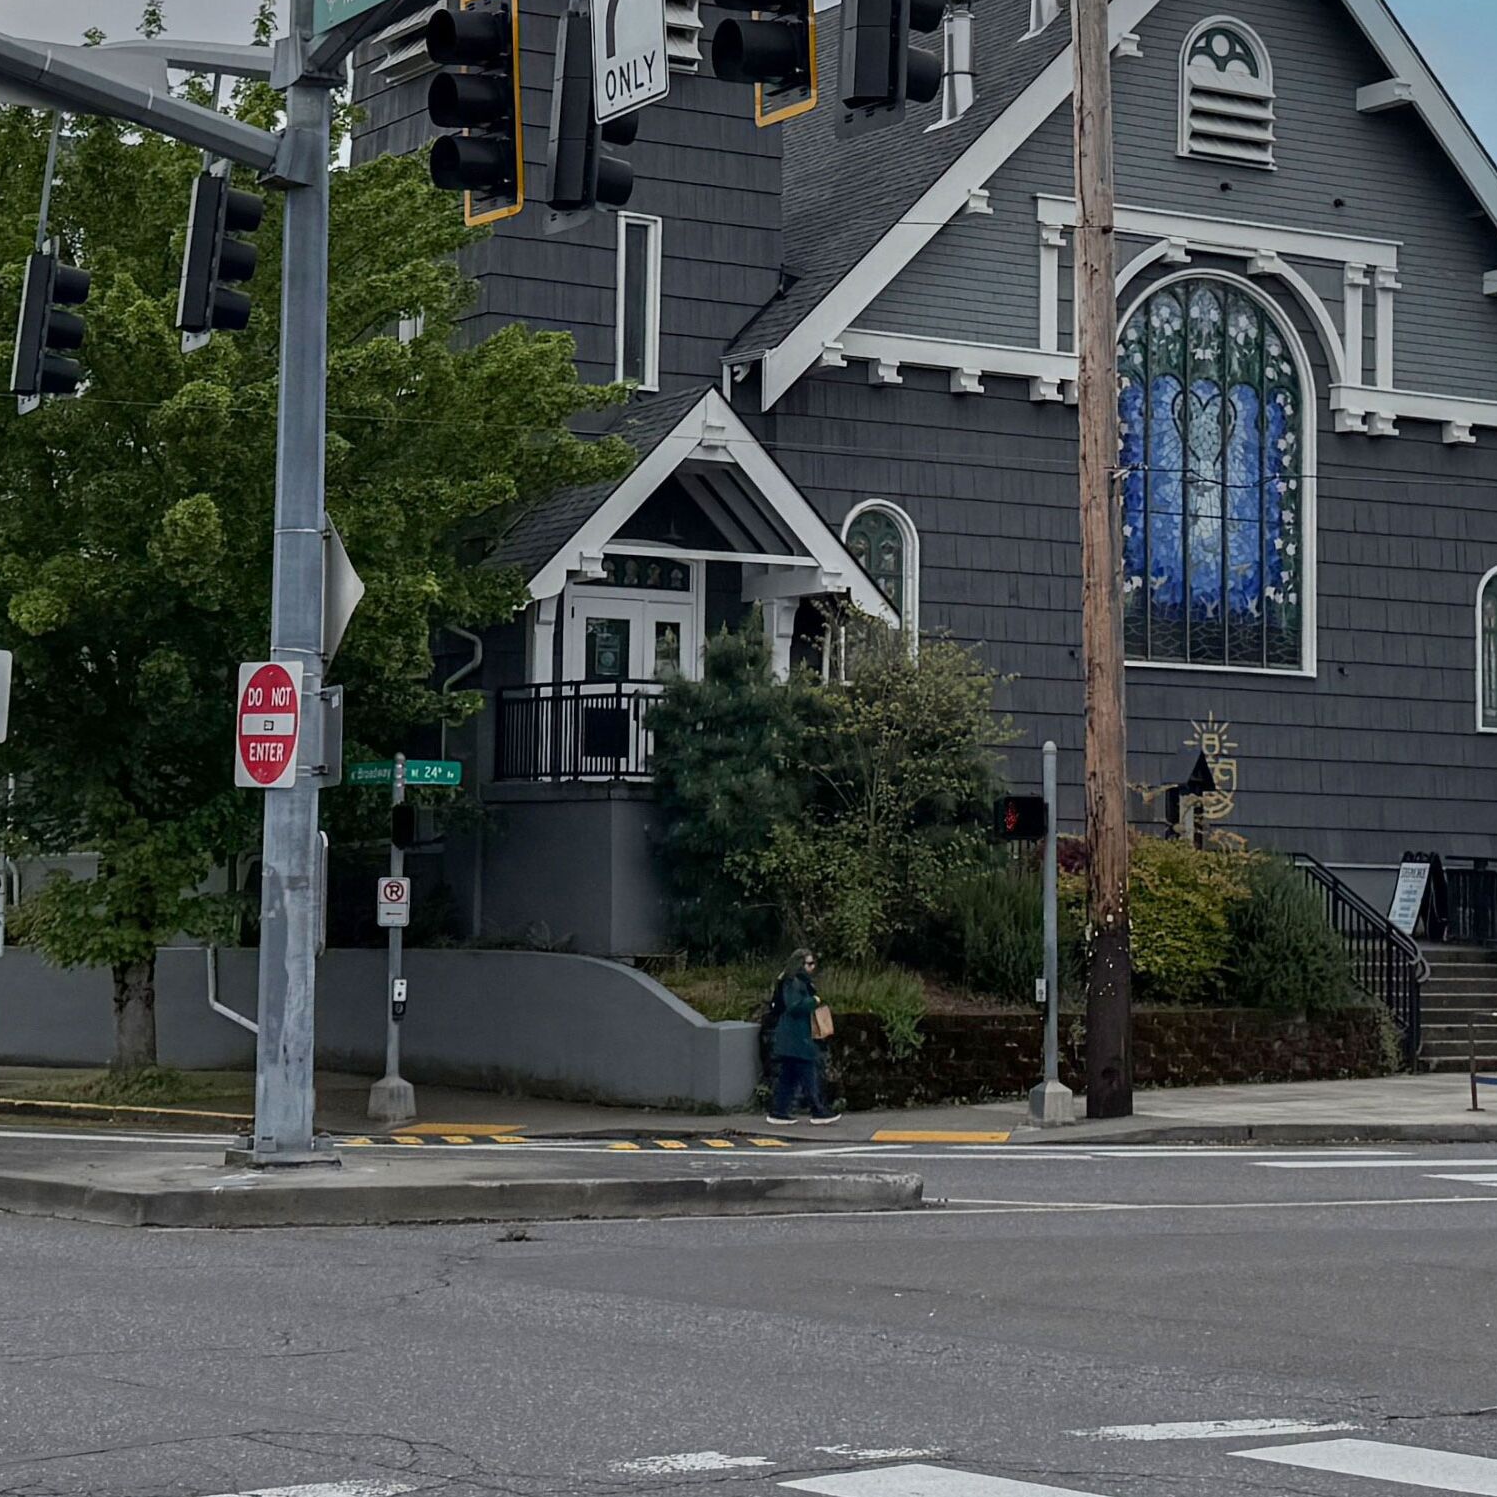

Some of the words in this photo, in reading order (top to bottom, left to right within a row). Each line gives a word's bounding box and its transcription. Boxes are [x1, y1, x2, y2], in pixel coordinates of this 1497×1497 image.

[605, 49, 656, 102] ONLY
[248, 687, 263, 707] DO
[271, 686, 292, 707] NOT
[249, 742, 284, 762] ENTER
